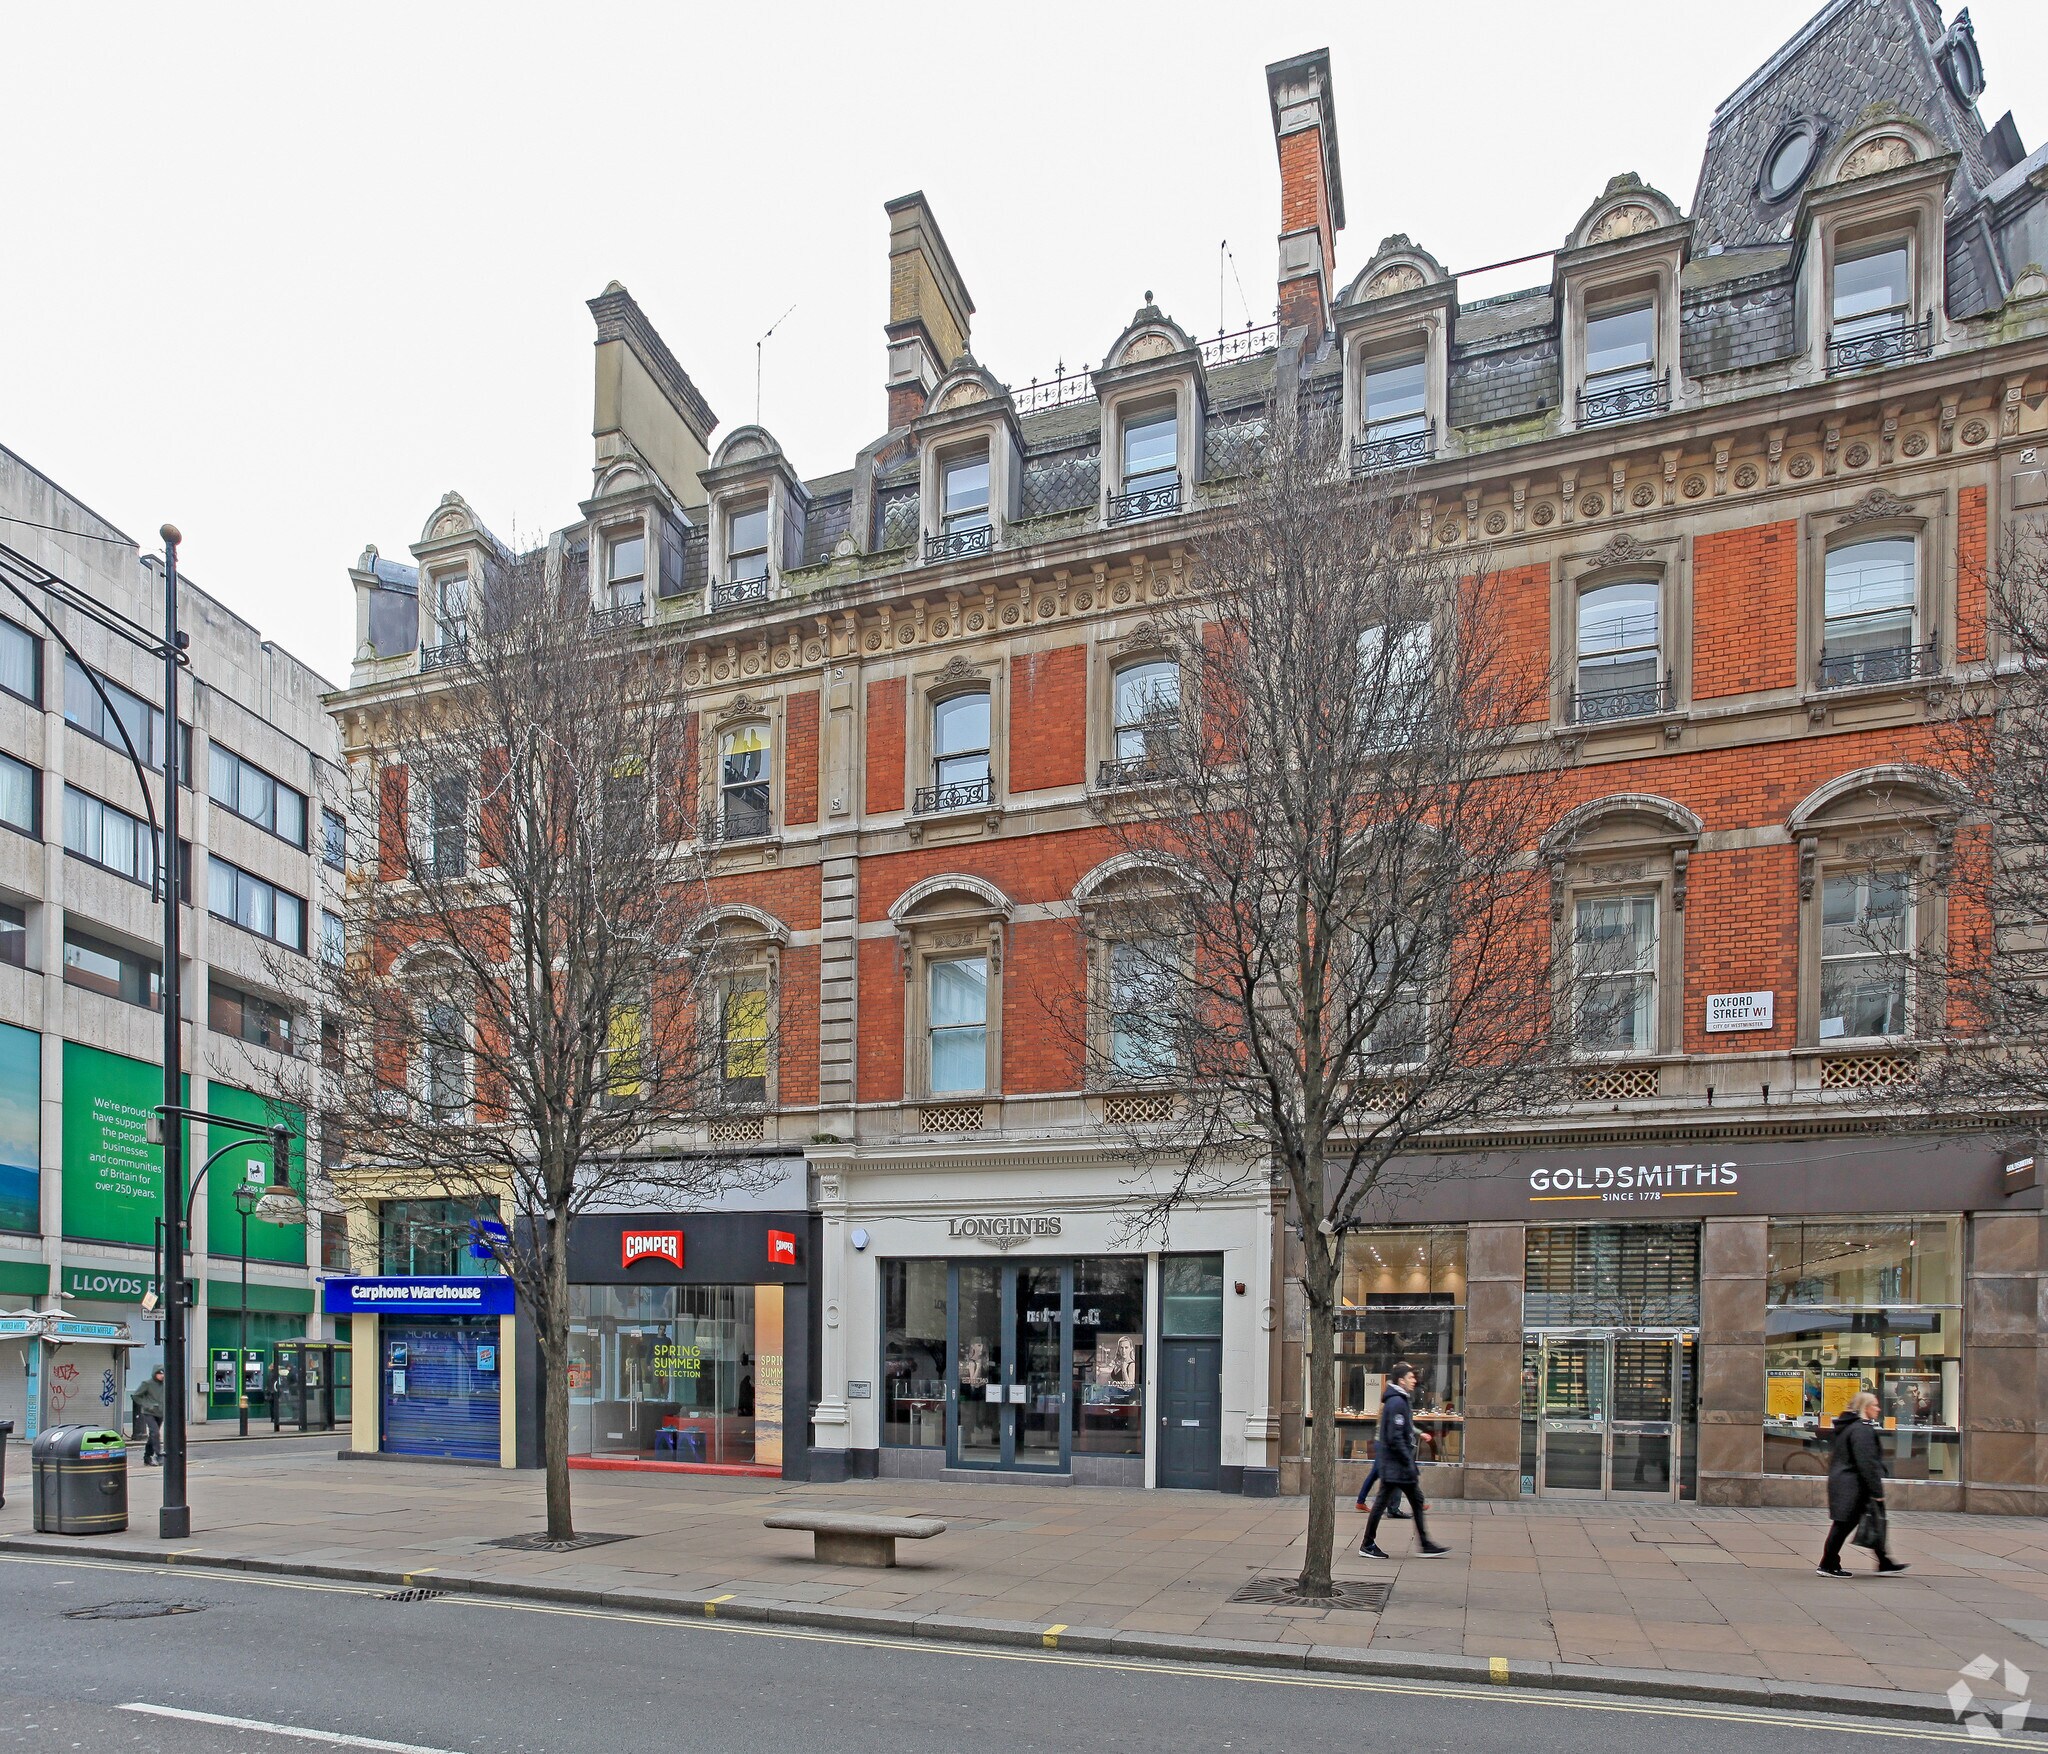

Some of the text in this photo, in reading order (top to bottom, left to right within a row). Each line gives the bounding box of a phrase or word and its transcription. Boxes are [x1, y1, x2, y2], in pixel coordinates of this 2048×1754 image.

[1713, 996, 1753, 1008] OXFORD
[1713, 1007, 1767, 1019] STREET W1
[94, 1097, 156, 1119] We're proud to
[92, 1111, 148, 1131] have support
[102, 1127, 117, 1137] the
[102, 1140, 149, 1158] businesses
[89, 1153, 162, 1174] and communities
[100, 1168, 151, 1184] of Britain for
[1529, 1162, 1738, 1191] GOLDSMITHS
[95, 1182, 157, 1199] over 250 years.
[1602, 1191, 1661, 1201] SINCE 1778
[949, 1217, 1063, 1236] LONGINES
[626, 1236, 677, 1259] CAMPER
[776, 1239, 794, 1255] CAMPER
[73, 1274, 142, 1295] LLOYDS
[351, 1284, 482, 1300] Carphone Warehouse
[654, 1344, 701, 1356] SPRING
[654, 1357, 701, 1369] SUMMER
[760, 1355, 783, 1366] SPRIN
[654, 1369, 701, 1378] COLLECTION
[760, 1367, 783, 1378] SUMM
[28, 1394, 37, 1430] GELATERIA
